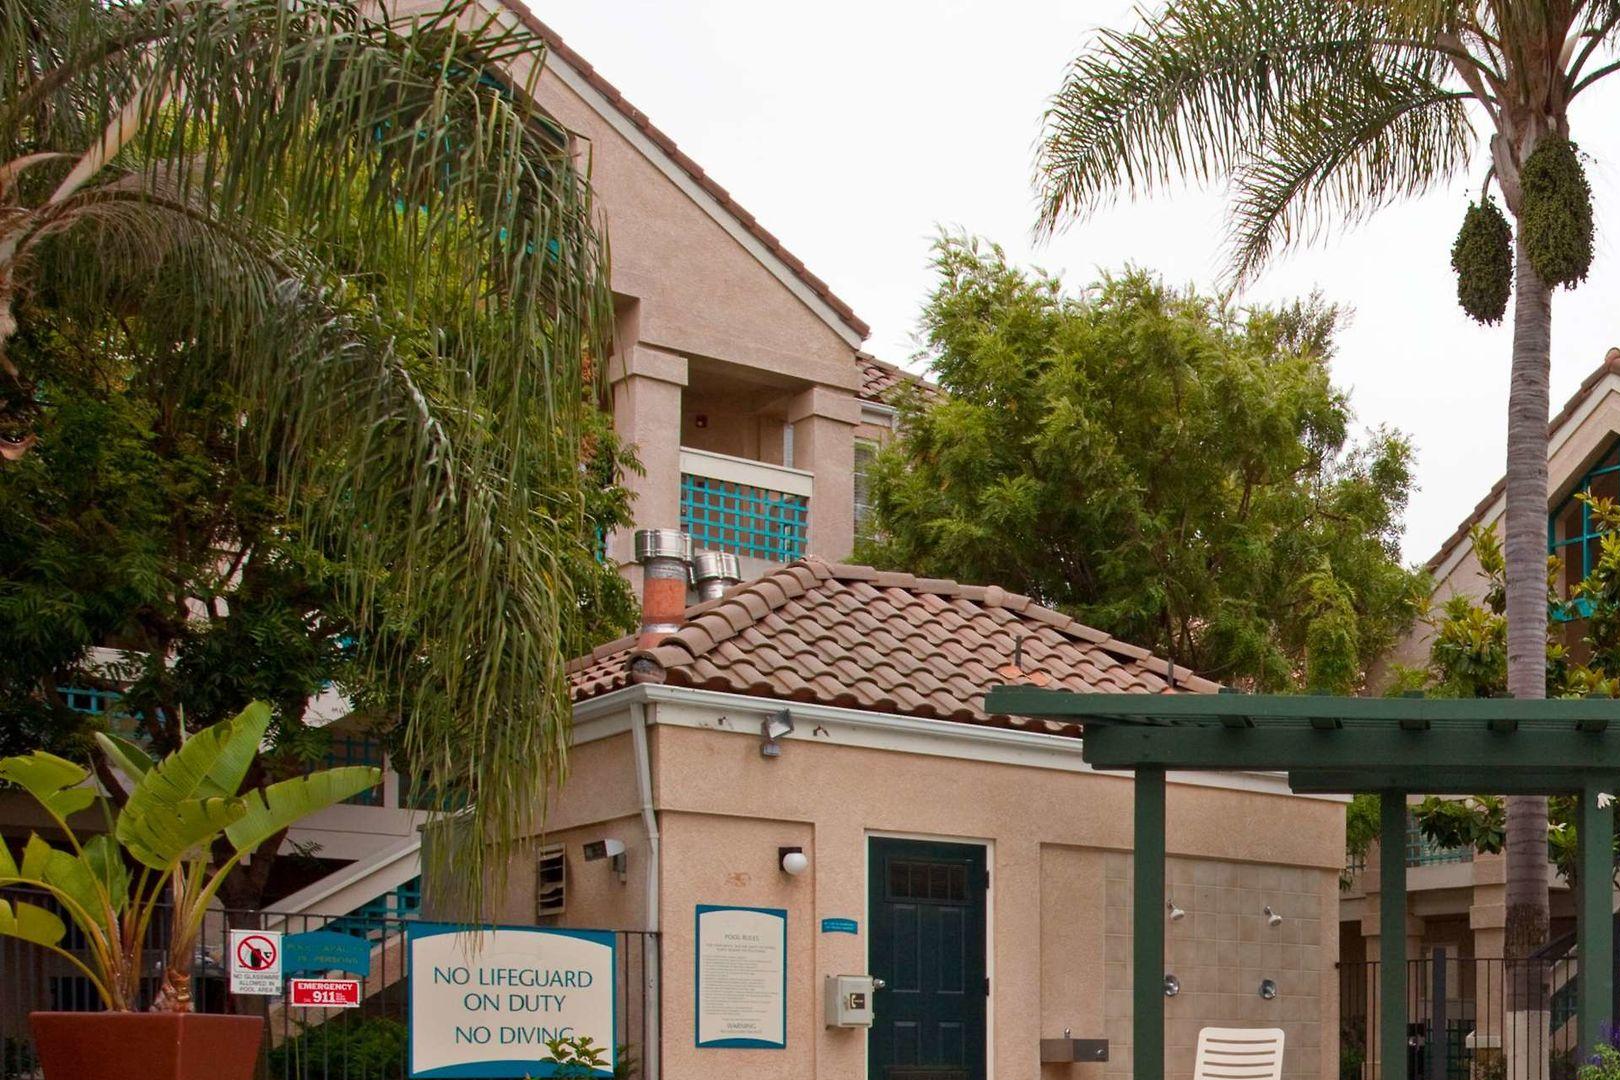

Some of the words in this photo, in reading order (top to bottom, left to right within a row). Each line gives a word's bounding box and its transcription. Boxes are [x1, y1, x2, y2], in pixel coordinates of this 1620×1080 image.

[434, 966, 470, 985] NO
[479, 967, 593, 988] LIFEGUARD
[297, 983, 353, 991] EMERGENCY
[312, 991, 336, 1003] 911
[464, 993, 500, 1012] ON
[509, 994, 566, 1012] DUTY
[455, 1026, 491, 1044] NO
[500, 1026, 575, 1045] DIVING
